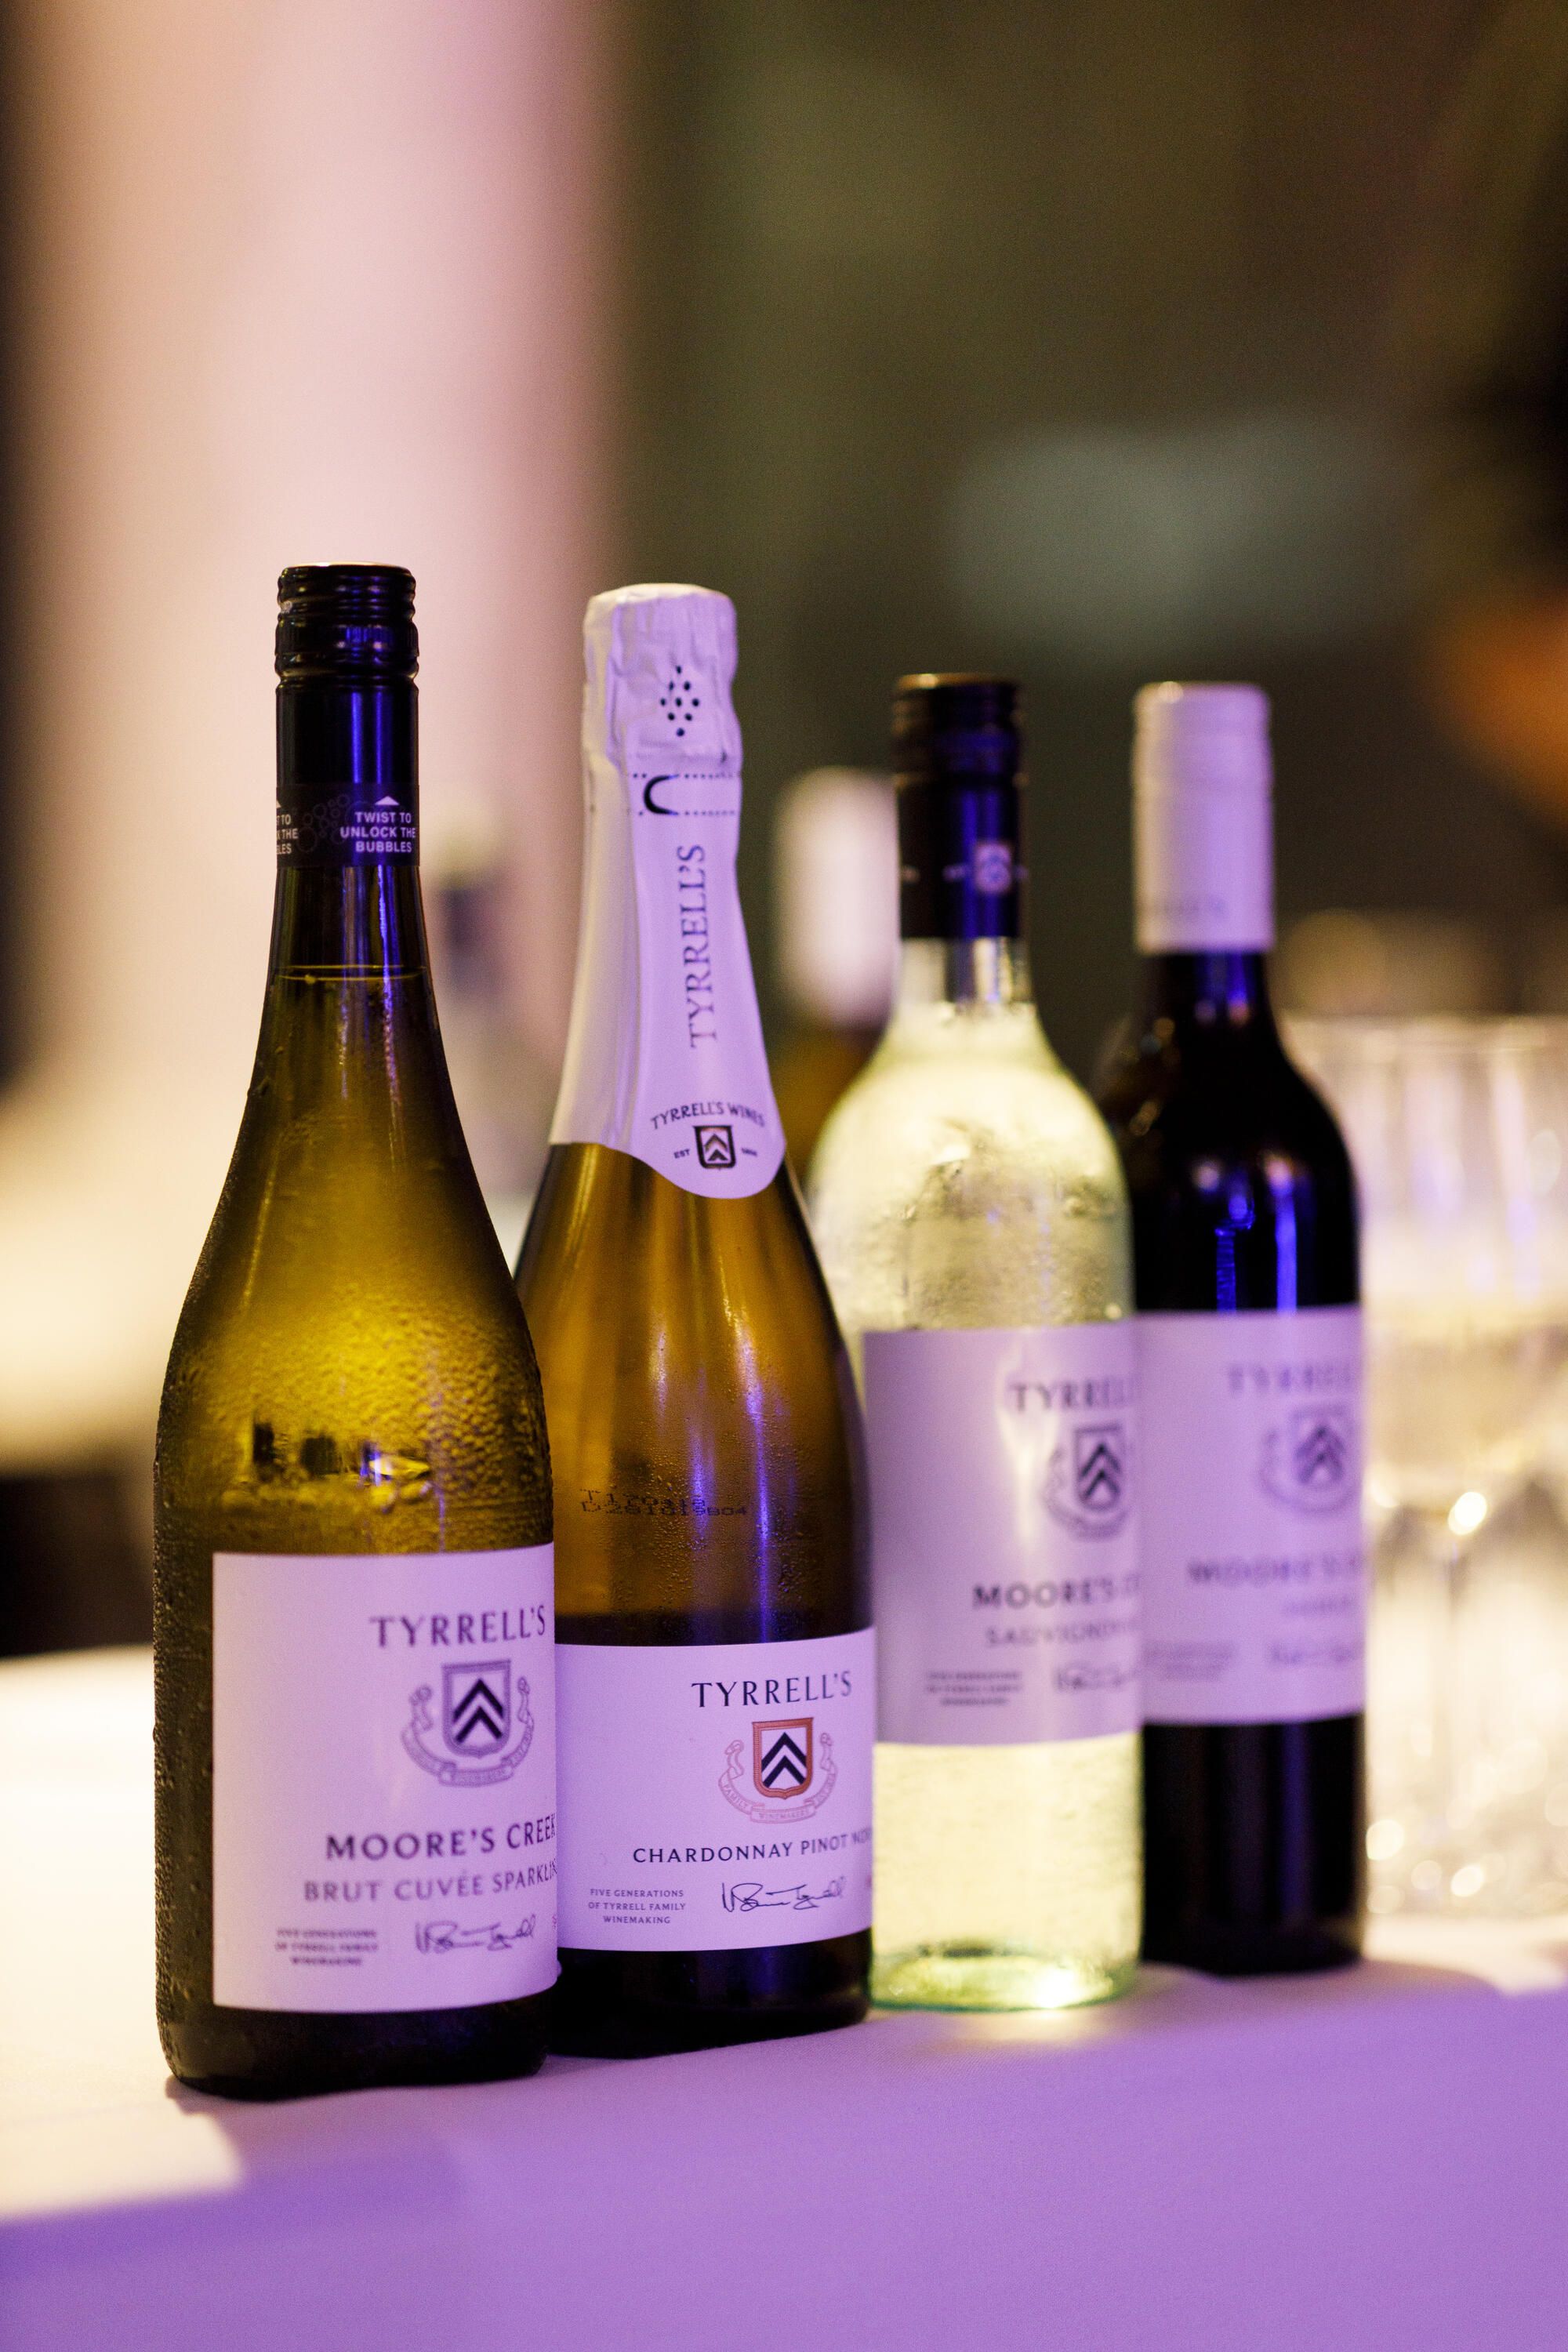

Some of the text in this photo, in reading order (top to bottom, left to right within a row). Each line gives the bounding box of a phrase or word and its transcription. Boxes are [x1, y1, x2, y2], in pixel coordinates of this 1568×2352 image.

[354, 811, 412, 824] TWIST TO
[281, 827, 299, 840] THE
[339, 826, 416, 839] UNLOCK THE
[355, 840, 412, 853] BUBBLES
[677, 844, 717, 1048] TYRRELL'S
[650, 1102, 765, 1131] TYRRELL'S WINES
[673, 1149, 691, 1160] EST
[368, 1604, 546, 1648] TYRRELL'S
[691, 1669, 853, 1709] TYRRELL'S
[325, 1812, 556, 1861] MOORE'S CREEK
[633, 1841, 793, 1864] CHARDONNAY
[800, 1833, 848, 1856] PINOT
[303, 1879, 383, 1903] BRUT
[394, 1868, 485, 1903] CUVÉE
[590, 1888, 684, 1898] FIVE GENERATIONS
[587, 1901, 686, 1911] OF TYRRELL FAMILY
[602, 1915, 671, 1925] WINEMAKING
